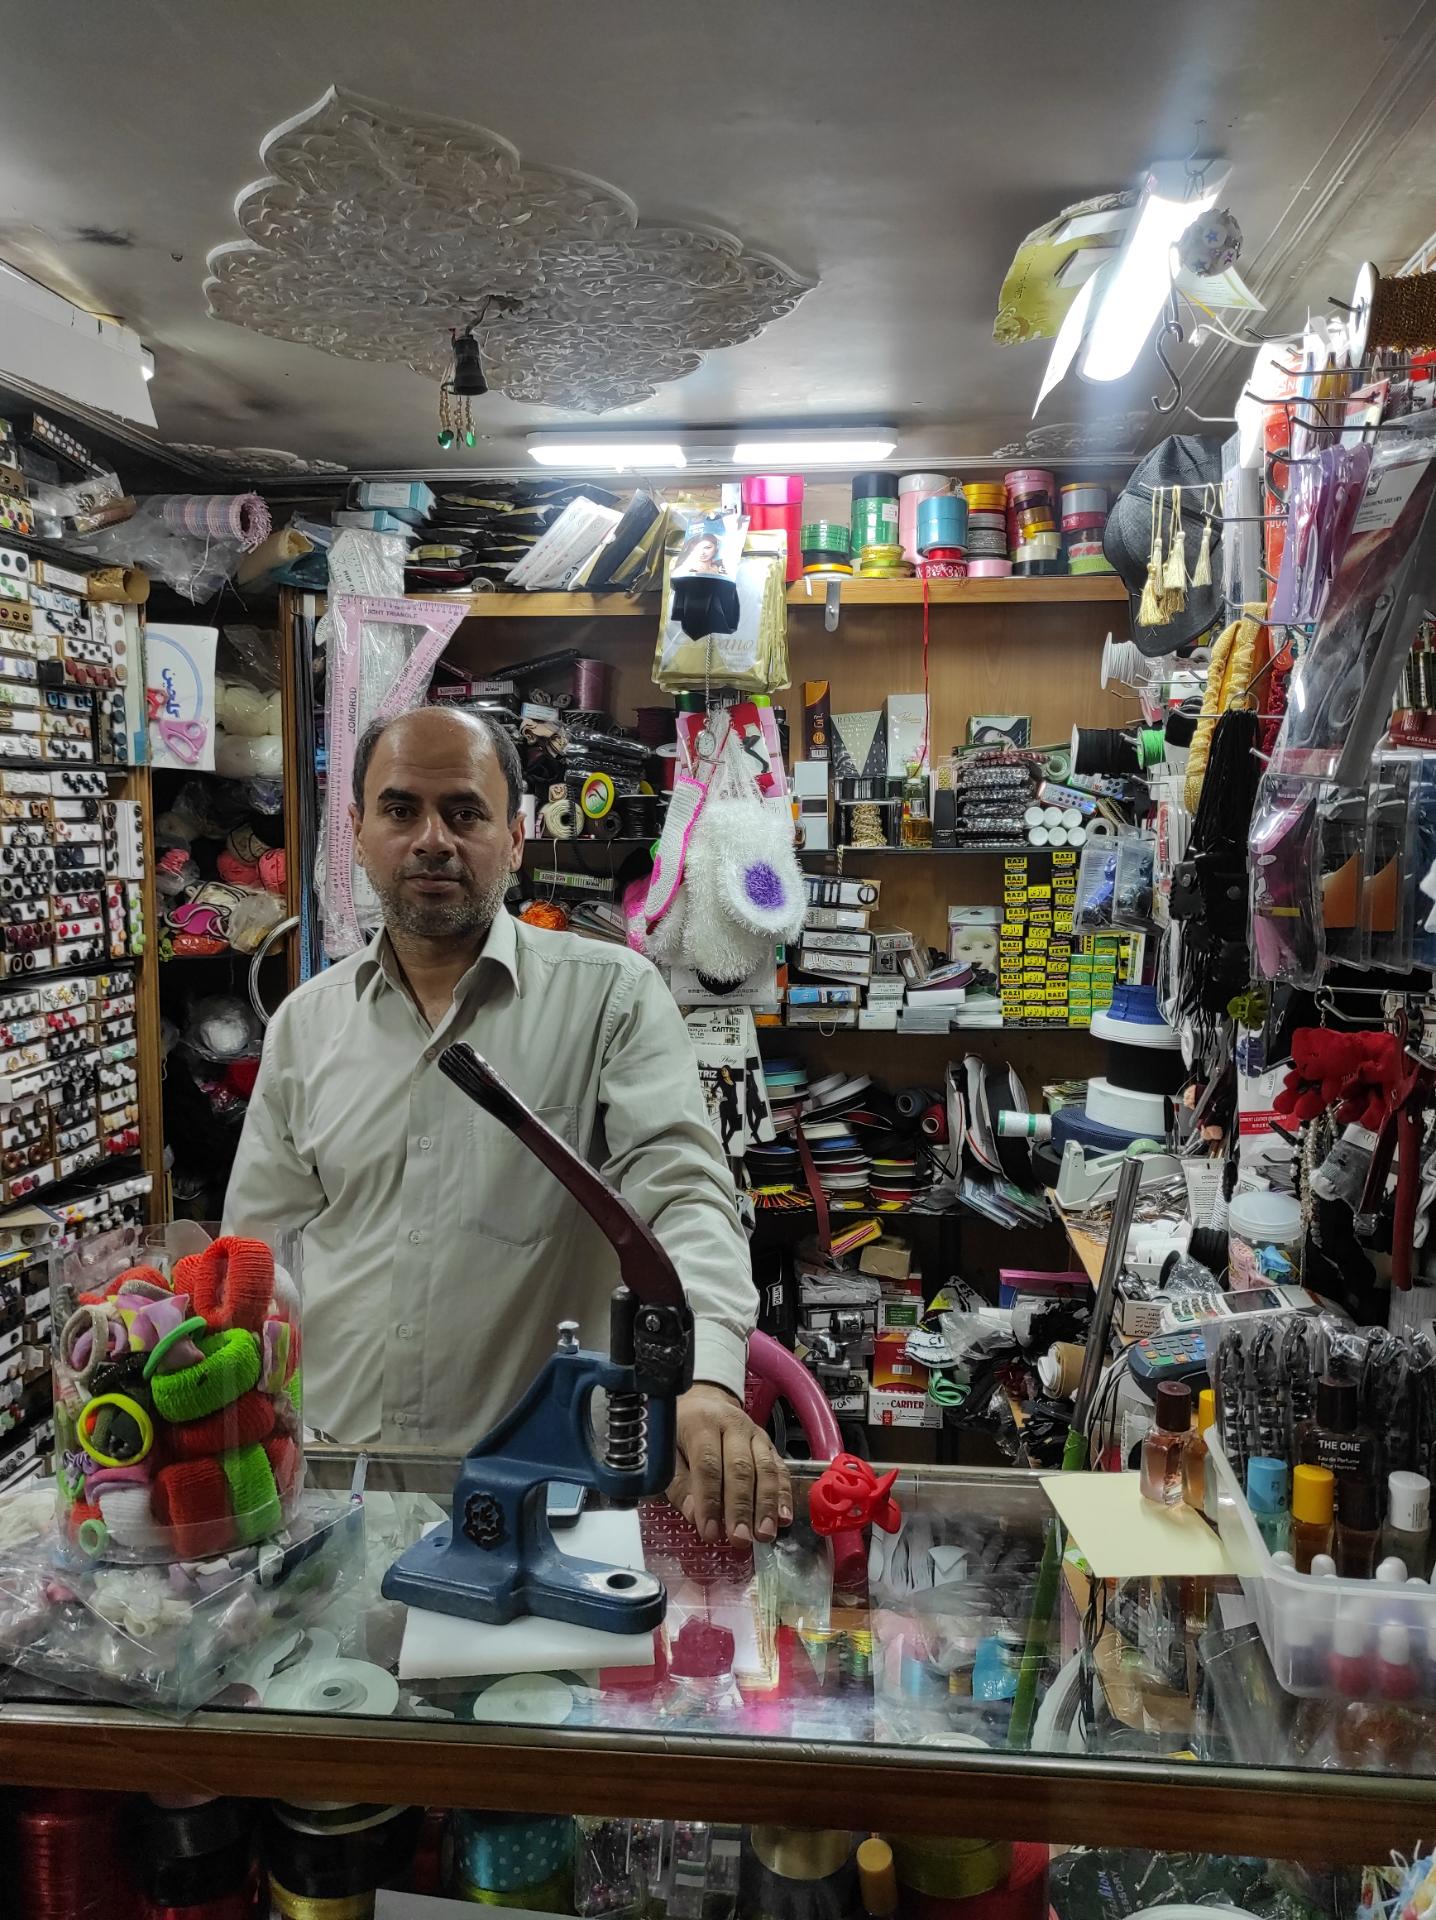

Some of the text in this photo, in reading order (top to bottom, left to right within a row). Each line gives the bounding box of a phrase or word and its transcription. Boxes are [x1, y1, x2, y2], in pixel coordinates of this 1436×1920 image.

[348, 686, 358, 735] ZOMOROD
[1030, 887, 1048, 898] رازی
[891, 1400, 925, 1410] CARIYER
[1319, 1440, 1361, 1452] THE ONE
